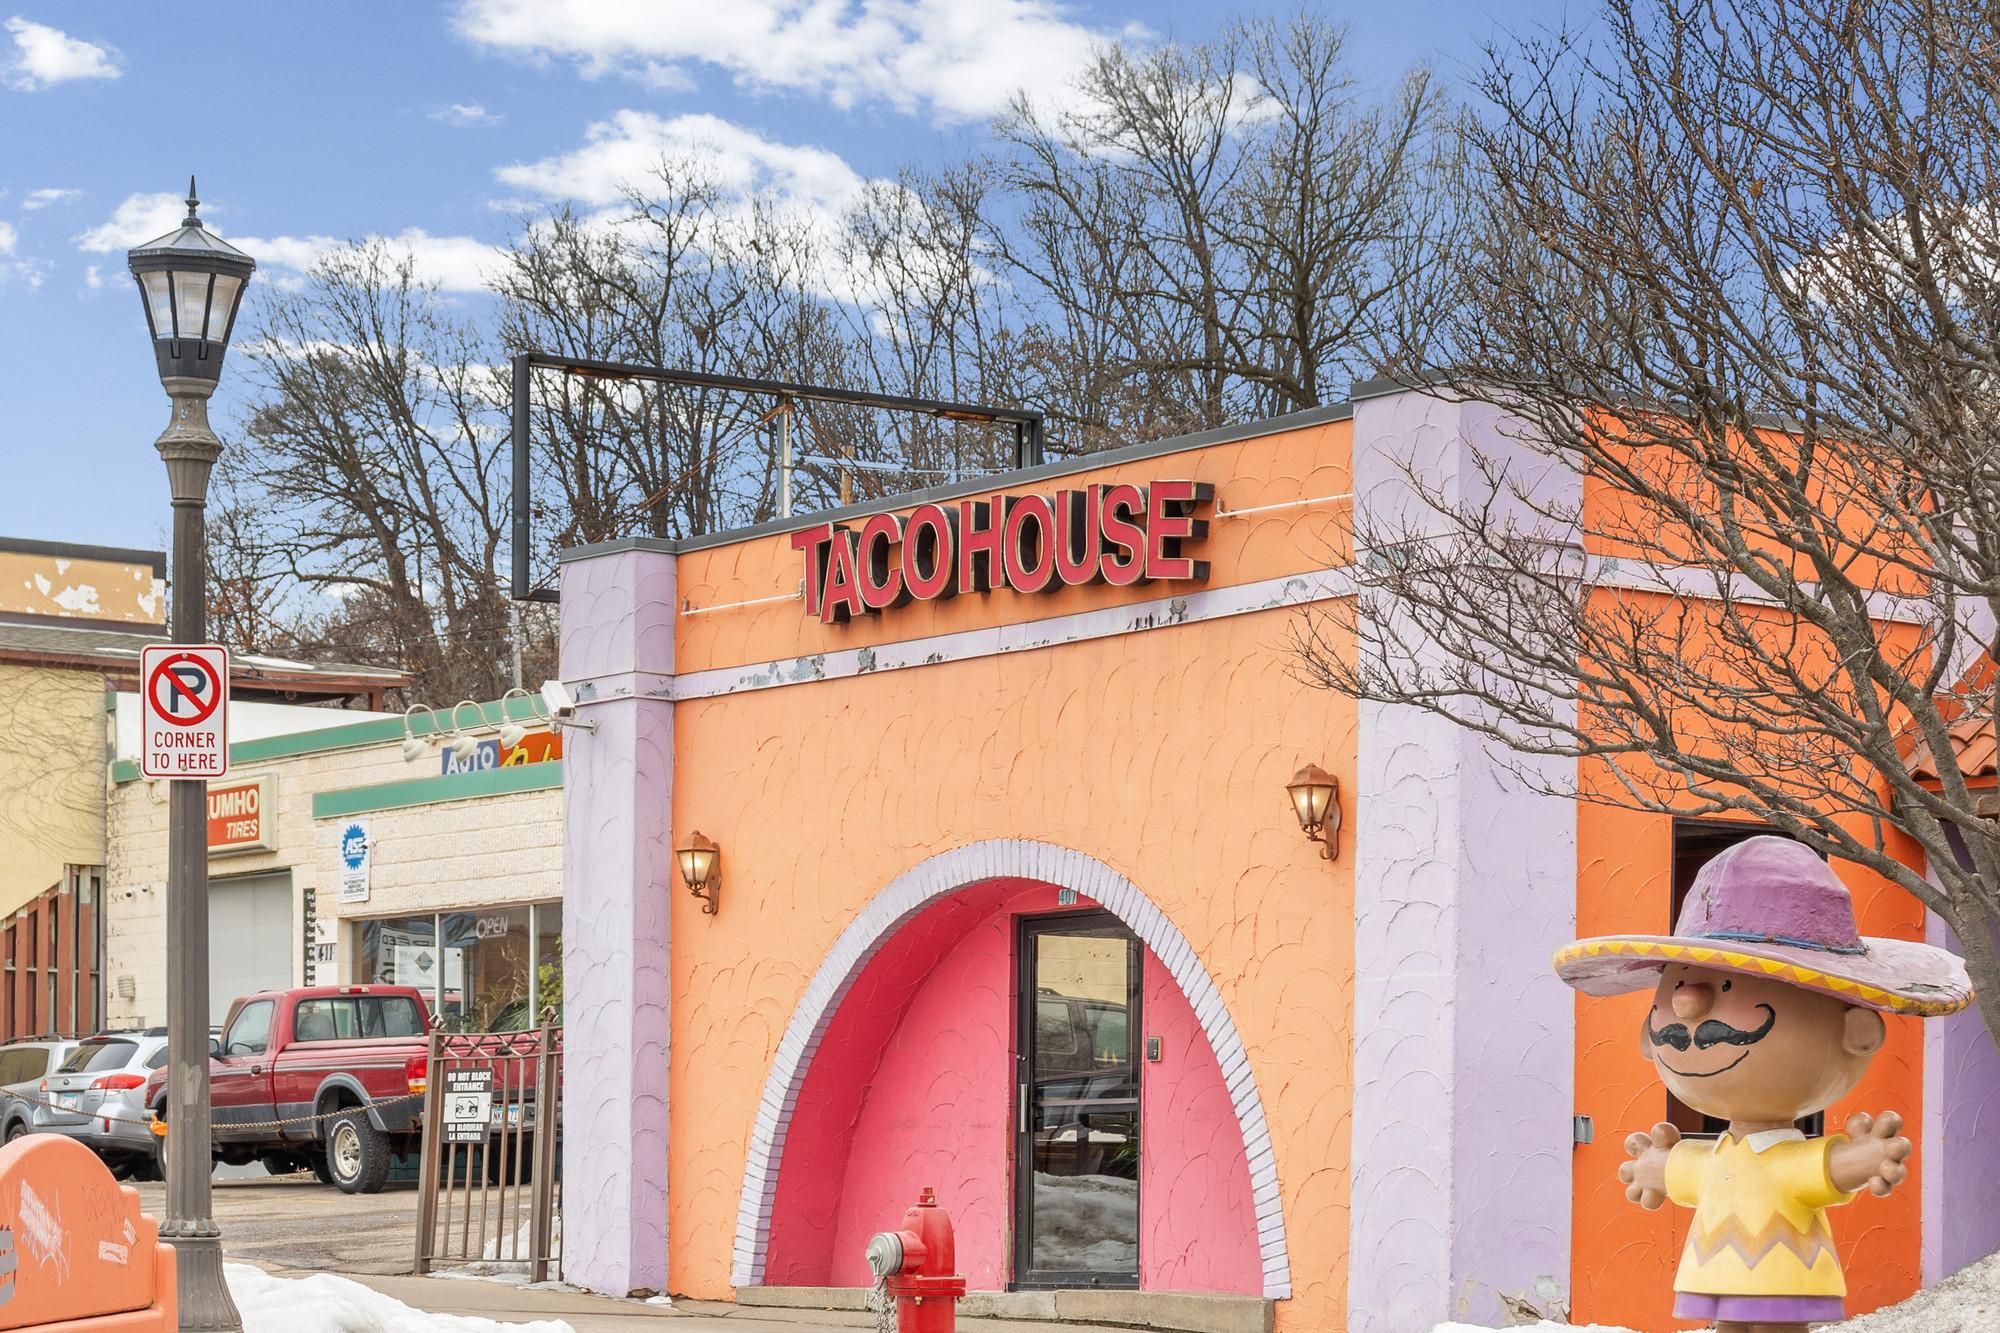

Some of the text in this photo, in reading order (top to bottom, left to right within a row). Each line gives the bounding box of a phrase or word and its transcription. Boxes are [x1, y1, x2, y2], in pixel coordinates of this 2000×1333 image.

[154, 731, 215, 748] CORNER
[152, 753, 218, 769] TO HERE
[446, 744, 494, 775] AUTO
[206, 788, 259, 820] UMHO
[226, 818, 258, 839] TIRES
[1060, 889, 1076, 905] 407
[476, 916, 508, 939] OPEN
[447, 1071, 492, 1082] DO NOT BLOCK
[453, 1082, 485, 1092] ENTRANCE
[447, 1123, 456, 1132] NO
[448, 1132, 481, 1141] LA ENTRADA
